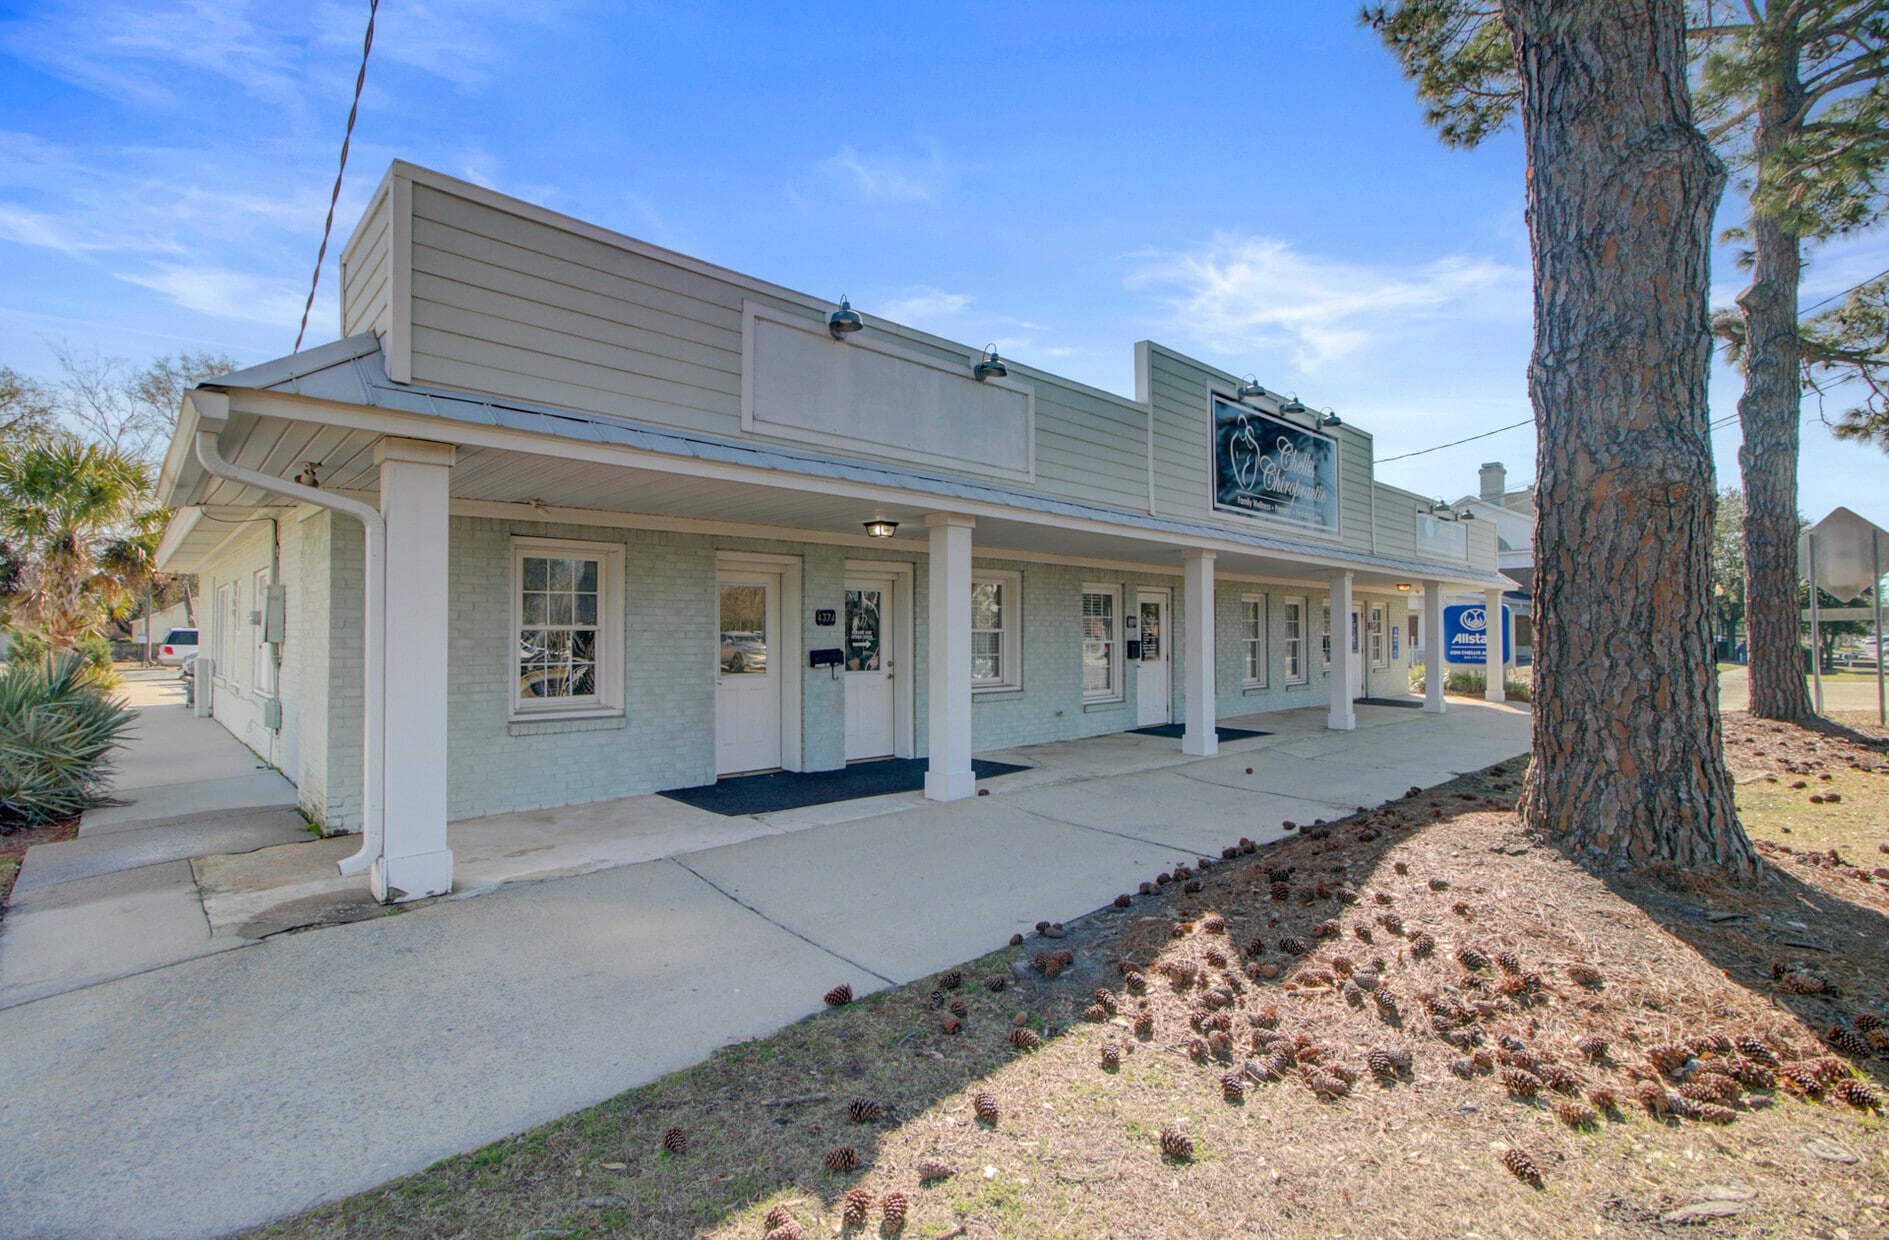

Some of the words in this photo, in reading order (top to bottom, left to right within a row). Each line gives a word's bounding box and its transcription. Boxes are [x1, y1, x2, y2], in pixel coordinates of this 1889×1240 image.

[1276, 435, 1315, 477] Chellis
[1260, 455, 1327, 506] Chiropractic
[1452, 633, 1487, 644] Allsta
